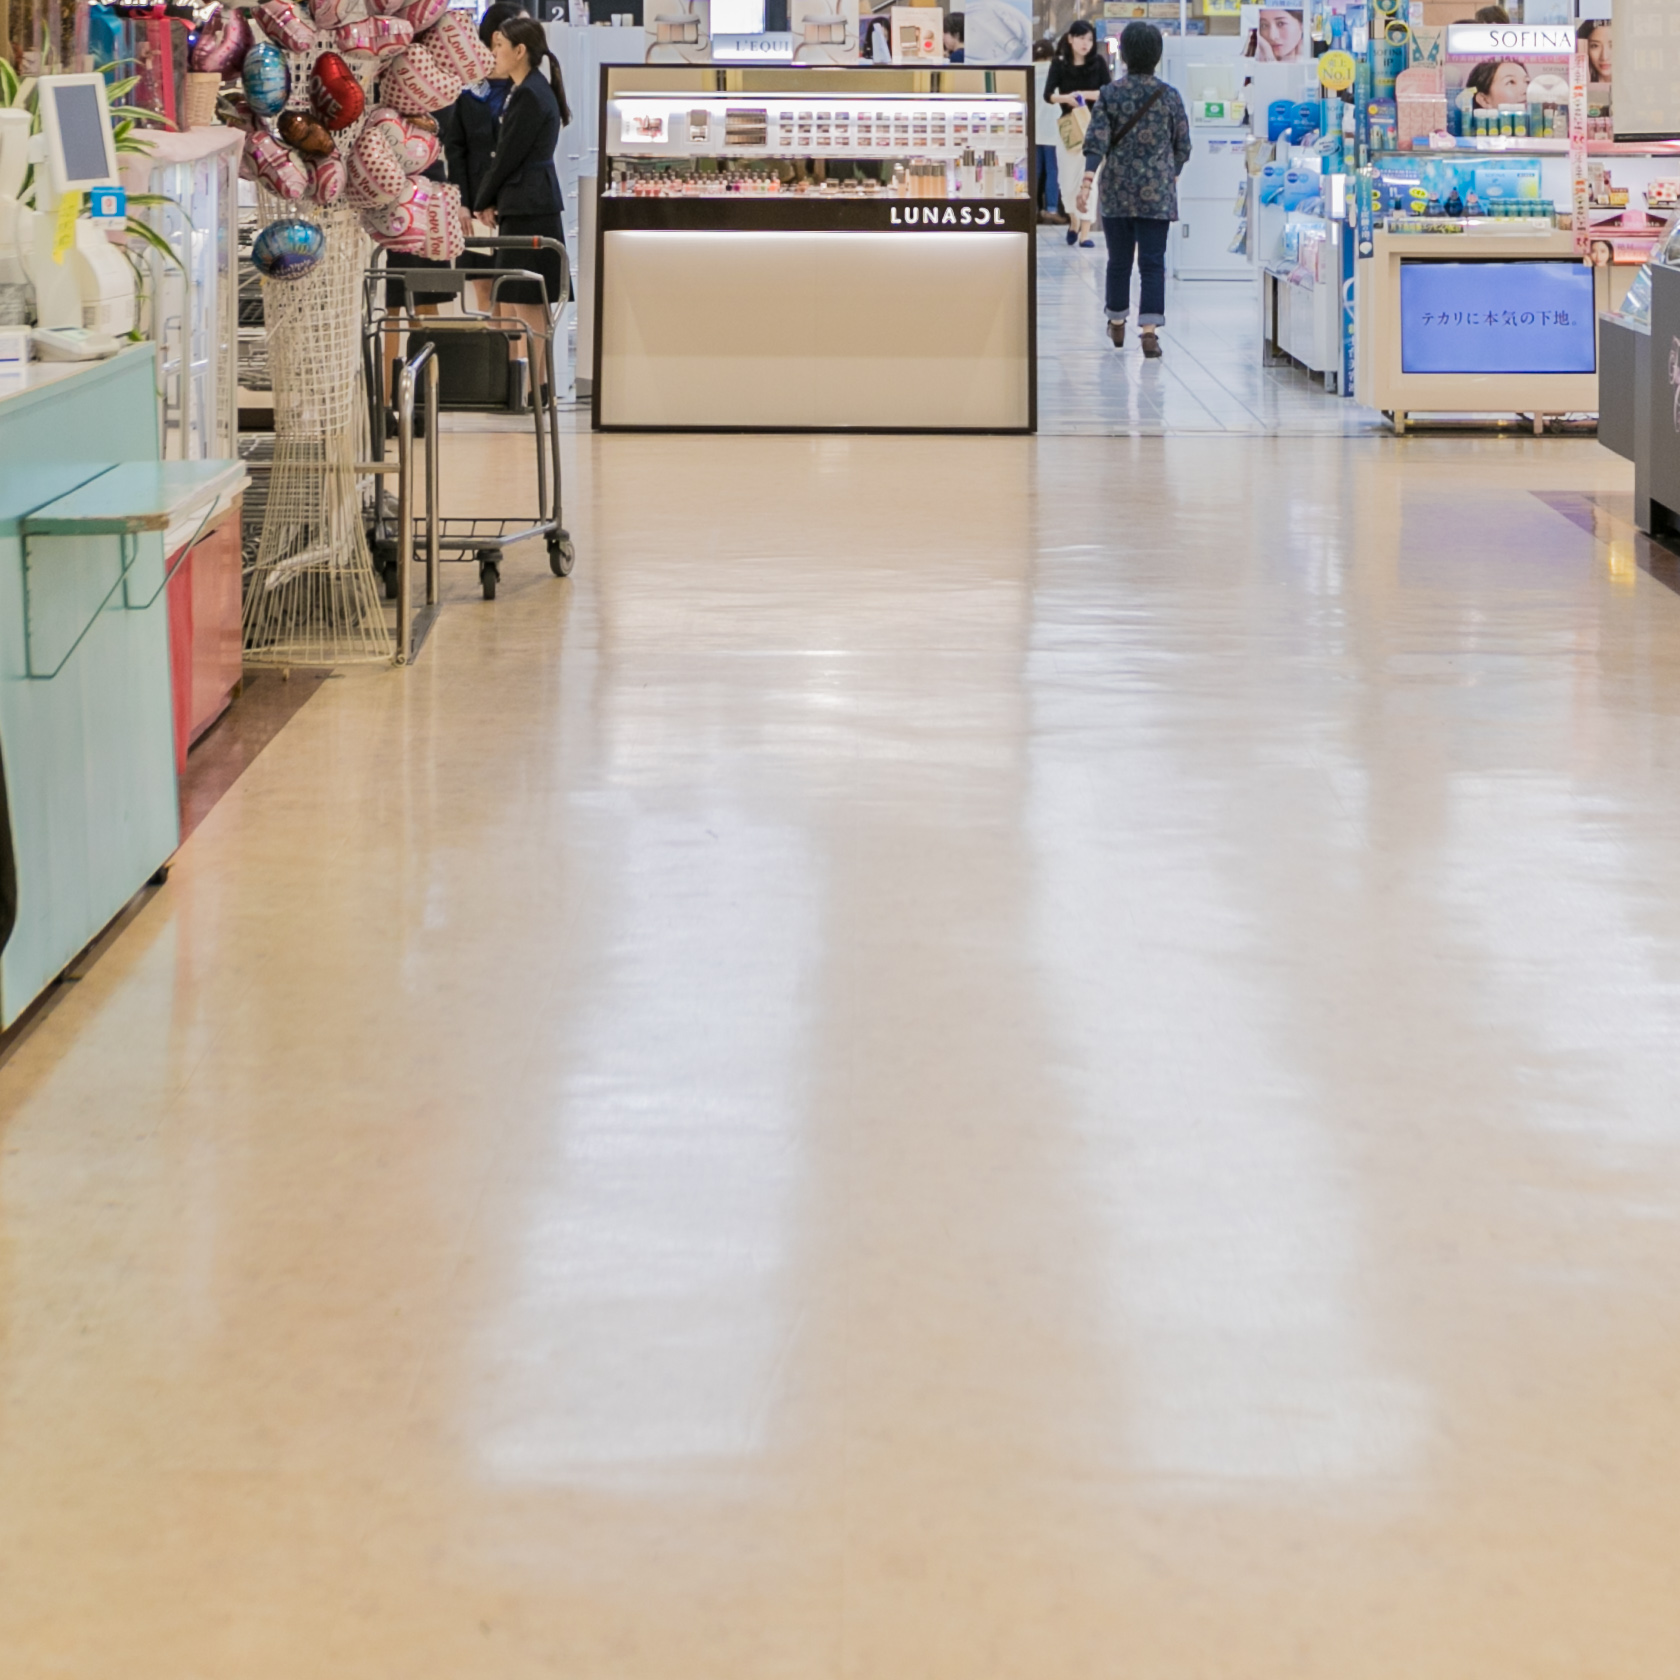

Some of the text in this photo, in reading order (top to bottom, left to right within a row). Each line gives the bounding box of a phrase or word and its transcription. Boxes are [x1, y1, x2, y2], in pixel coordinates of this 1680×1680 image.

[551, 6, 565, 22] 2
[447, 33, 469, 63] Love
[1489, 30, 1572, 48] SOFINA
[1323, 67, 1351, 80] No.1
[402, 76, 429, 101] Love
[428, 202, 441, 234] Love
[891, 206, 1005, 224] LUNASOL
[430, 235, 444, 256] You
[1421, 309, 1577, 327] テカリに本気の下地。
